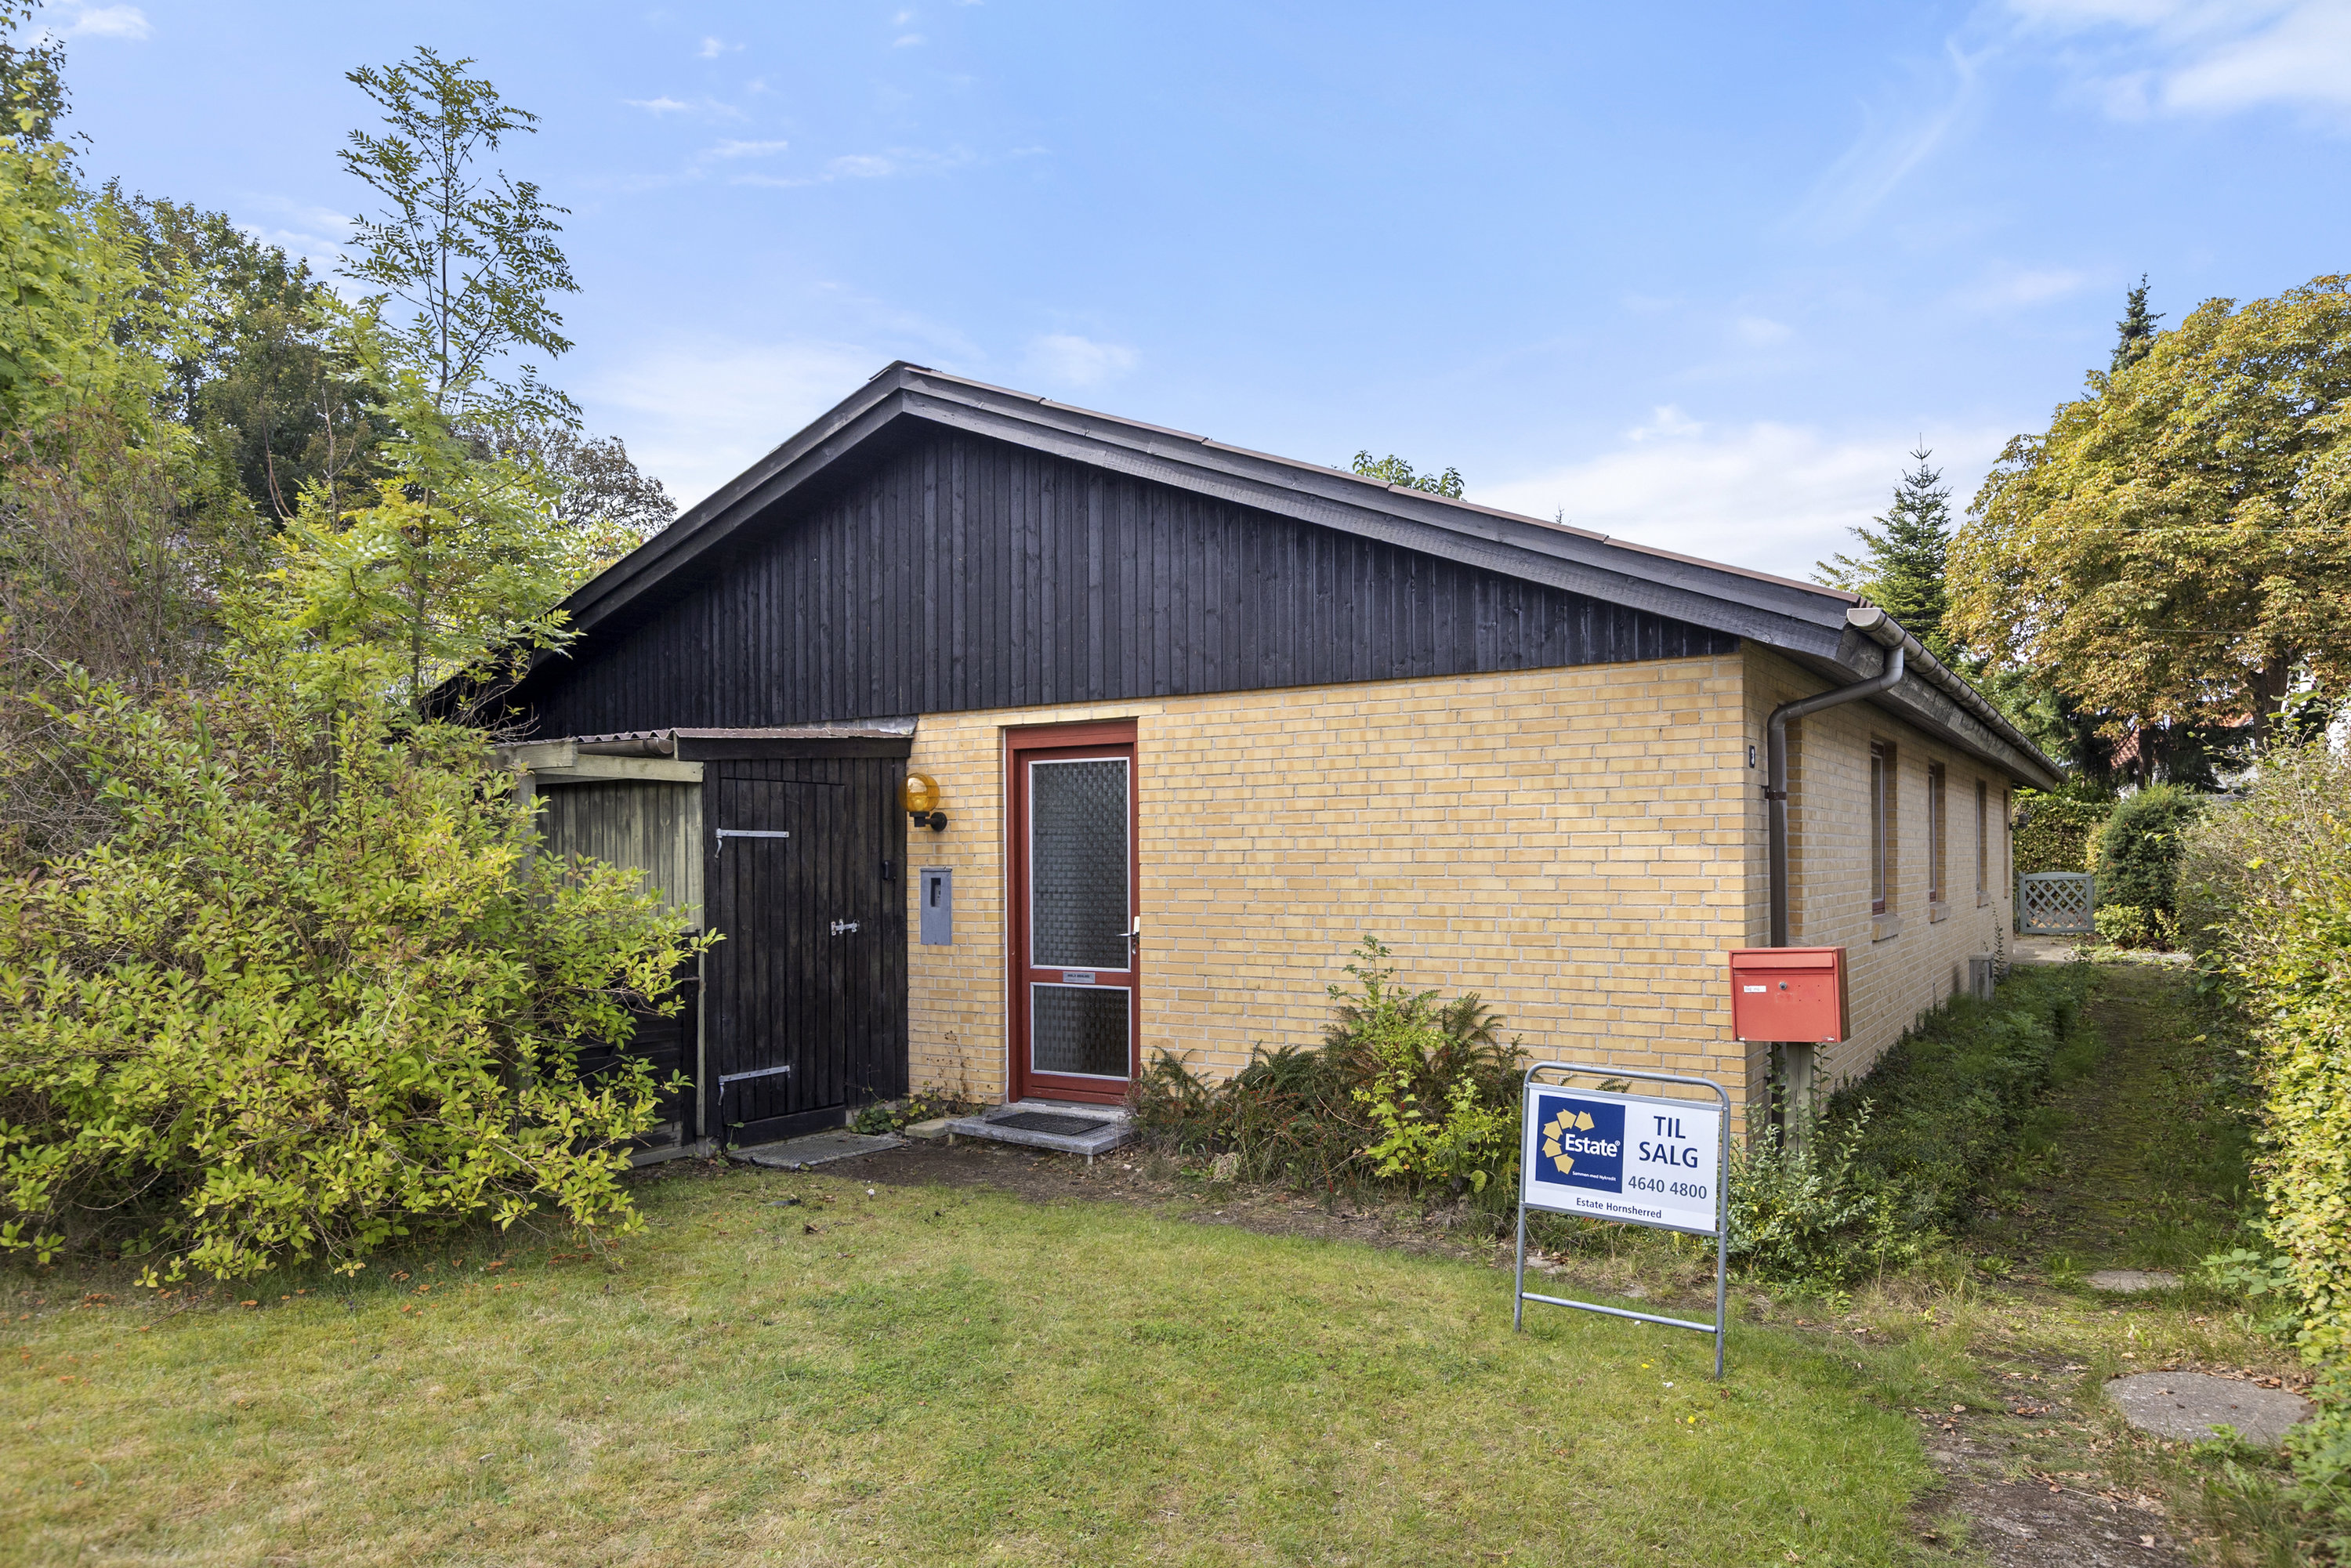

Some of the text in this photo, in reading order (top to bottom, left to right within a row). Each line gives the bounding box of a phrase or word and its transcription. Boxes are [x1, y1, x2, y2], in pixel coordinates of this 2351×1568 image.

[1654, 1115, 1686, 1139] TIL
[1639, 1141, 1698, 1168] SALG
[1628, 1175, 1707, 1200] 4640 4800
[1576, 1197, 1662, 1219] Estate Hornsherred
